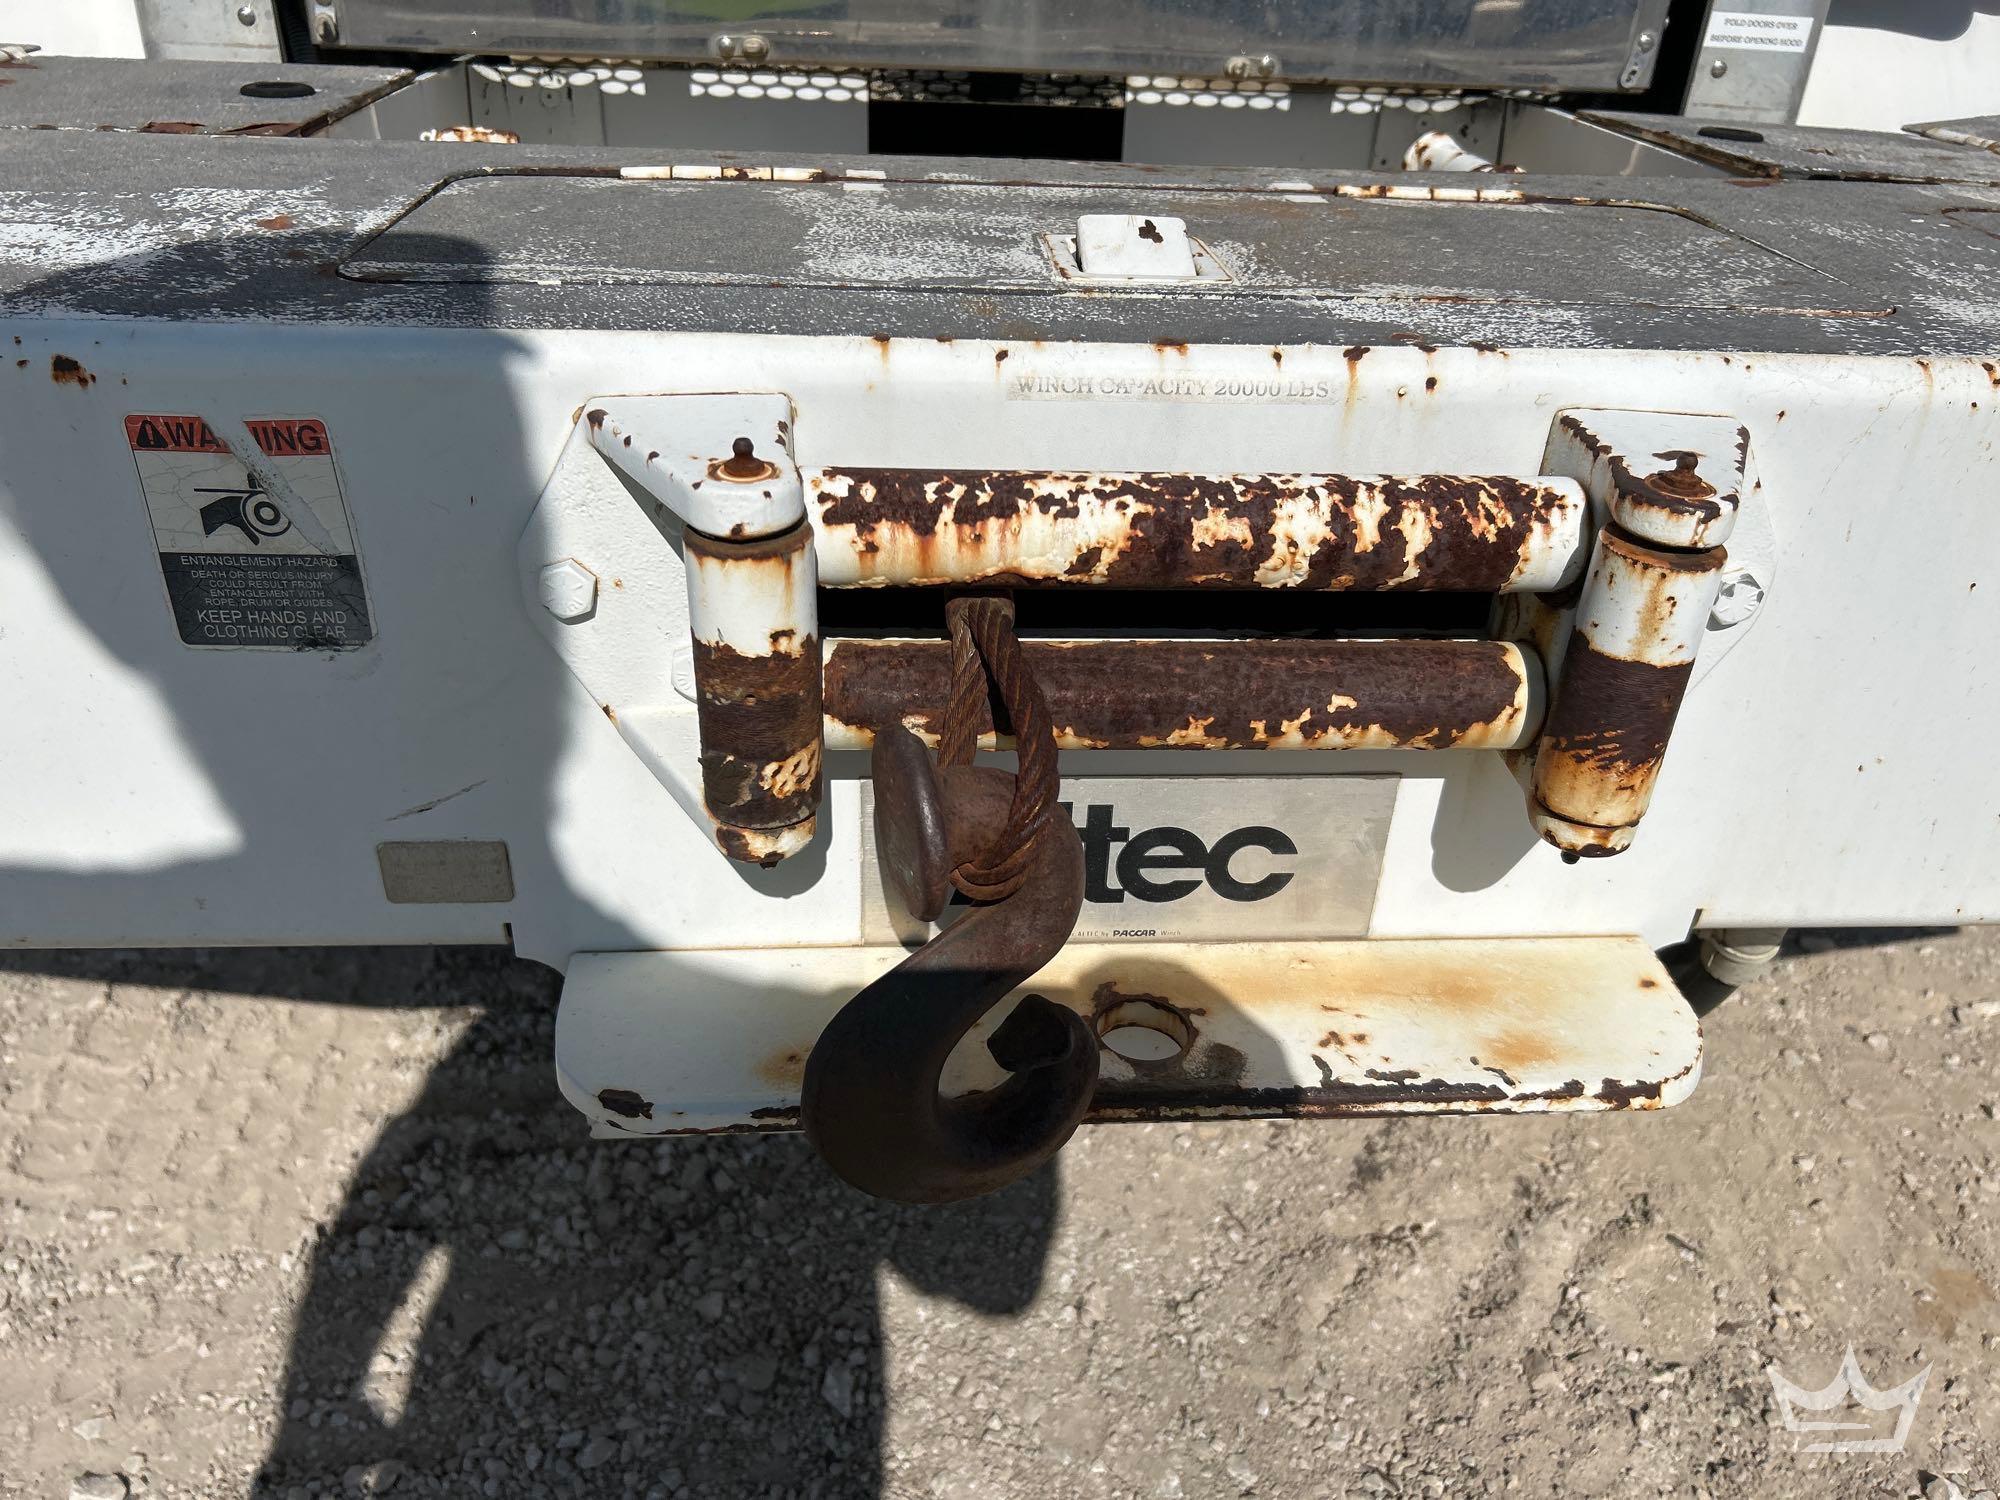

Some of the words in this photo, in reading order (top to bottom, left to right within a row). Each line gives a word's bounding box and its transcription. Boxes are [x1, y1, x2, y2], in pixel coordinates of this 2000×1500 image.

[1747, 20, 1775, 29] DOORS
[1016, 376, 1093, 394] WINCH
[1214, 380, 1282, 397] 20000
[1285, 381, 1330, 399] LBS
[163, 421, 322, 451] WAING
[181, 555, 284, 567] ENTANGLEMENT
[287, 557, 338, 568] HAZARD
[191, 570, 227, 579] DEATH
[229, 571, 245, 580] OR
[247, 571, 295, 580] SERIOUS
[296, 572, 334, 581] INJURY
[209, 579, 246, 589] COULD
[248, 580, 288, 589] RESULT
[291, 581, 322, 590] FROM
[210, 588, 295, 599] ENTANGLEMENT
[298, 590, 325, 598] WITH
[241, 599, 273, 608] DRUM
[275, 599, 292, 608] OR
[294, 599, 334, 608] GUIDES
[197, 609, 242, 623] KEEP
[248, 610, 307, 625] HANDS
[312, 611, 347, 624] AND
[204, 624, 288, 639] CLOTHING
[950, 800, 1298, 906] tec
[1113, 929, 1156, 937] PACCAR
